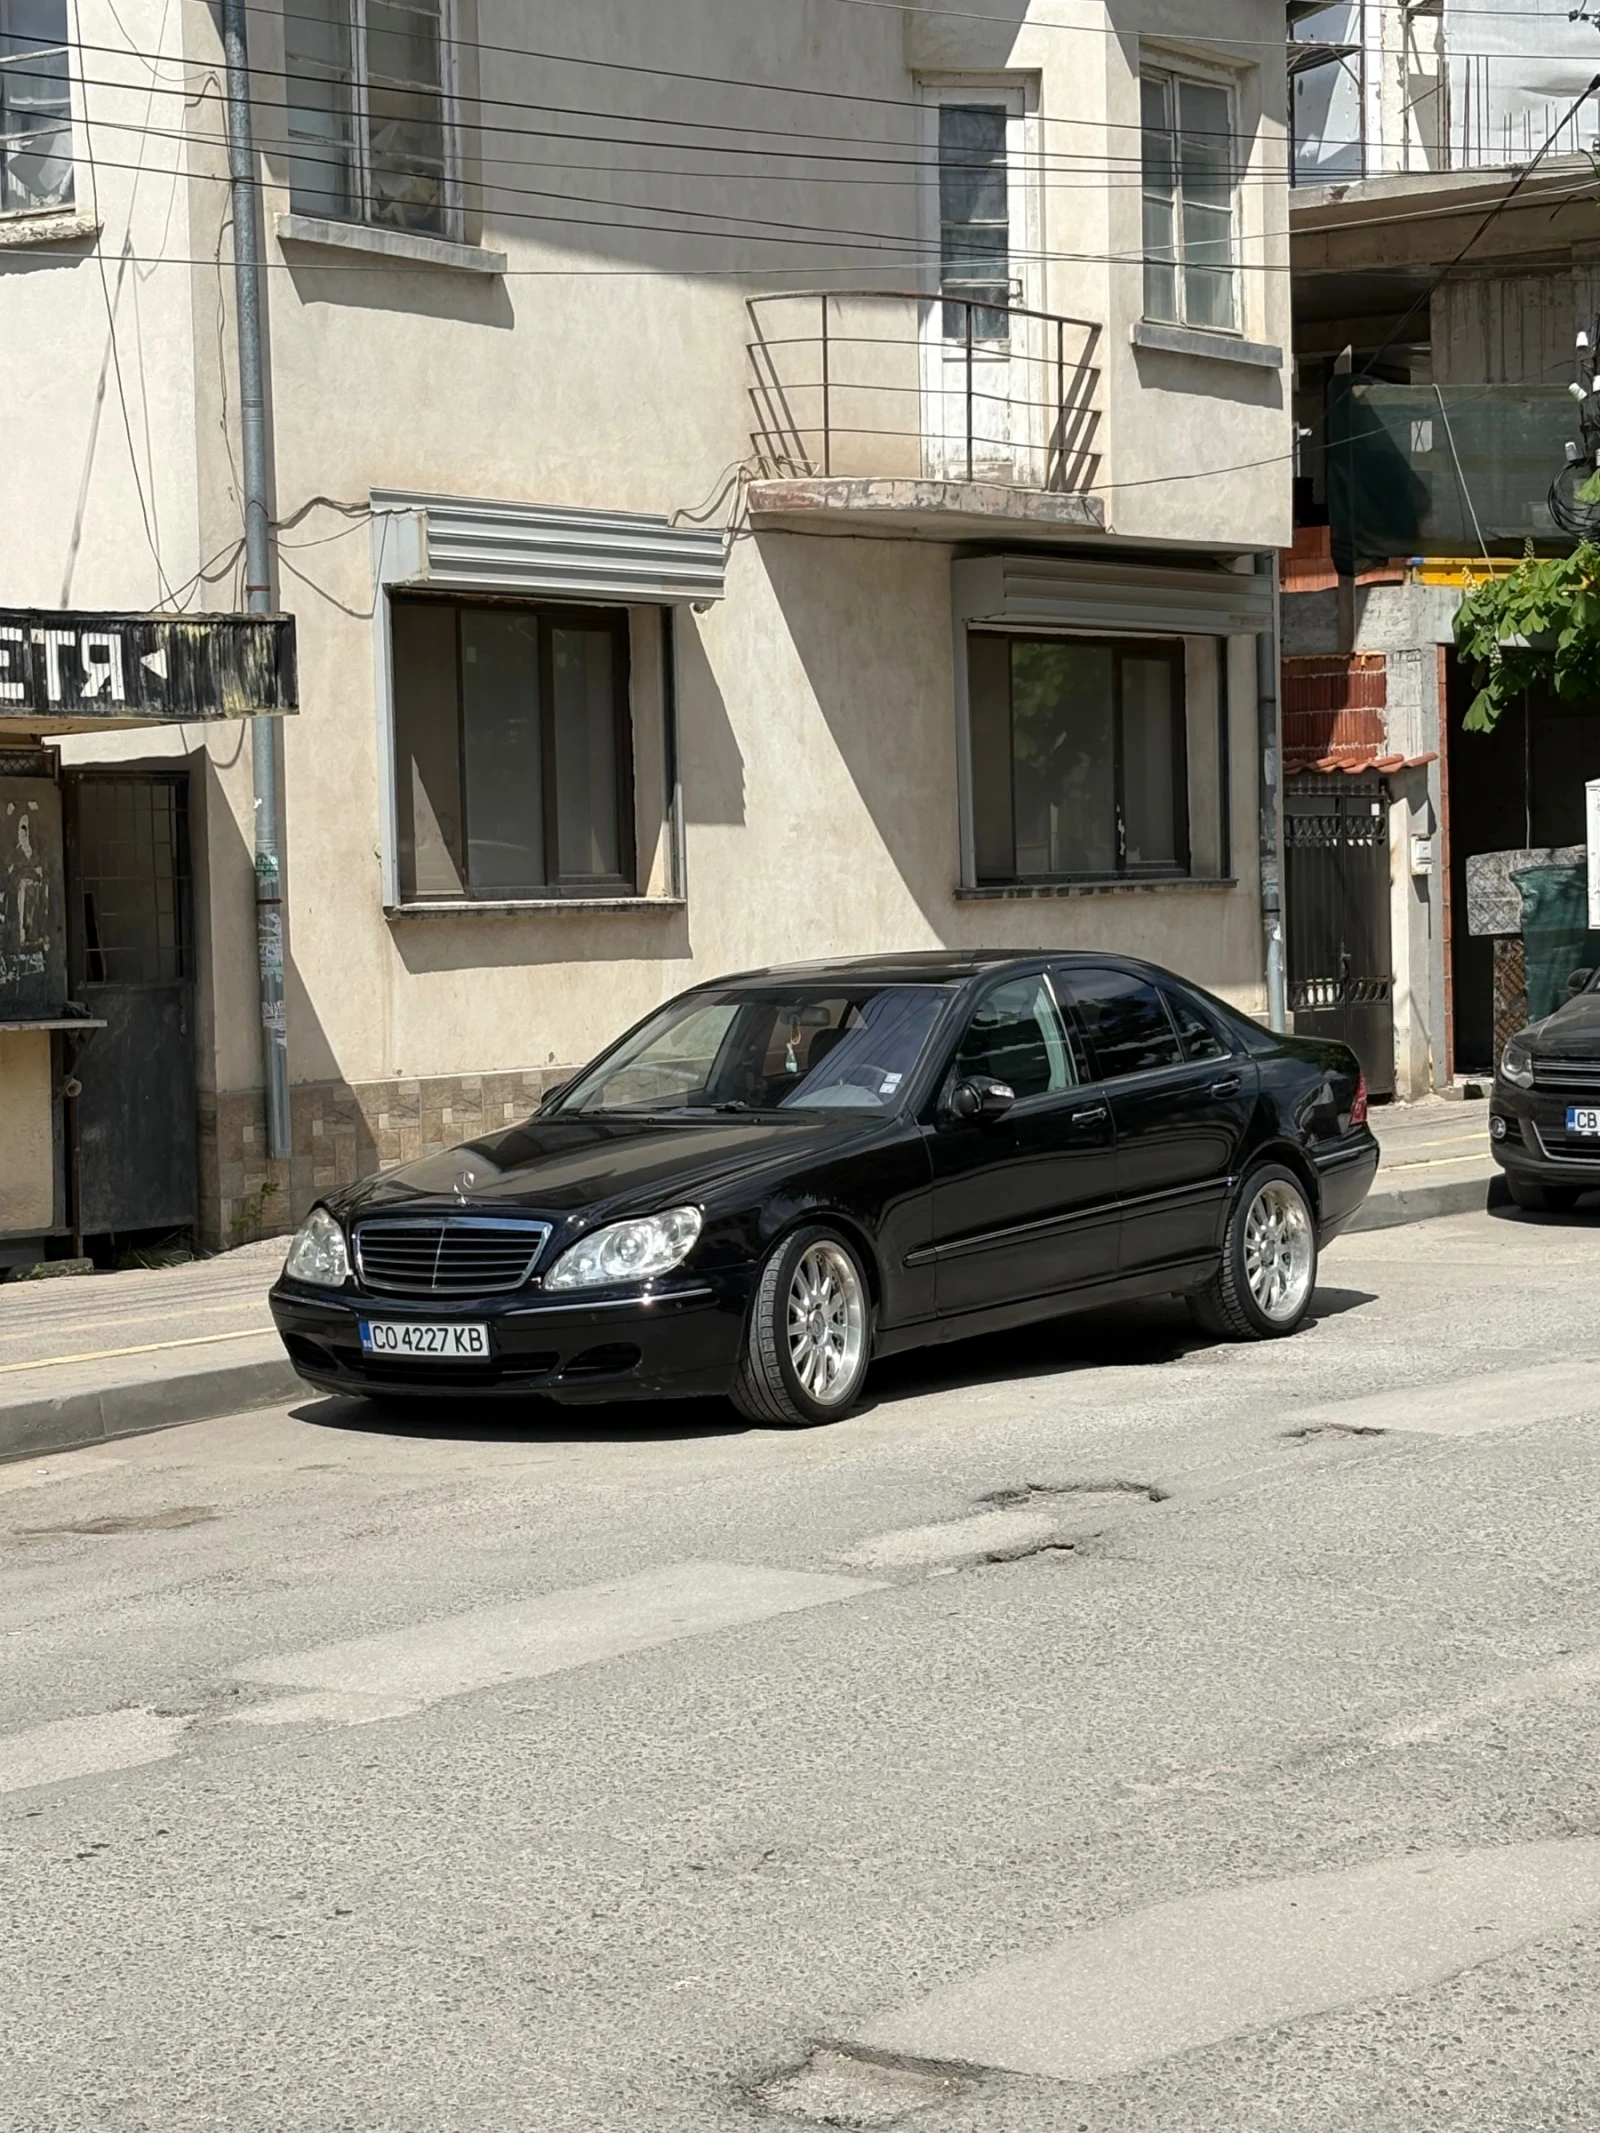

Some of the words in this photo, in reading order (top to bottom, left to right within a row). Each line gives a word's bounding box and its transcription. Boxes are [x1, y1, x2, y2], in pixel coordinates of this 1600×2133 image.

[1577, 1112, 1597, 1128] CB
[373, 1325, 398, 1350] CO
[402, 1327, 449, 1352] 4227
[453, 1327, 484, 1353] KB
